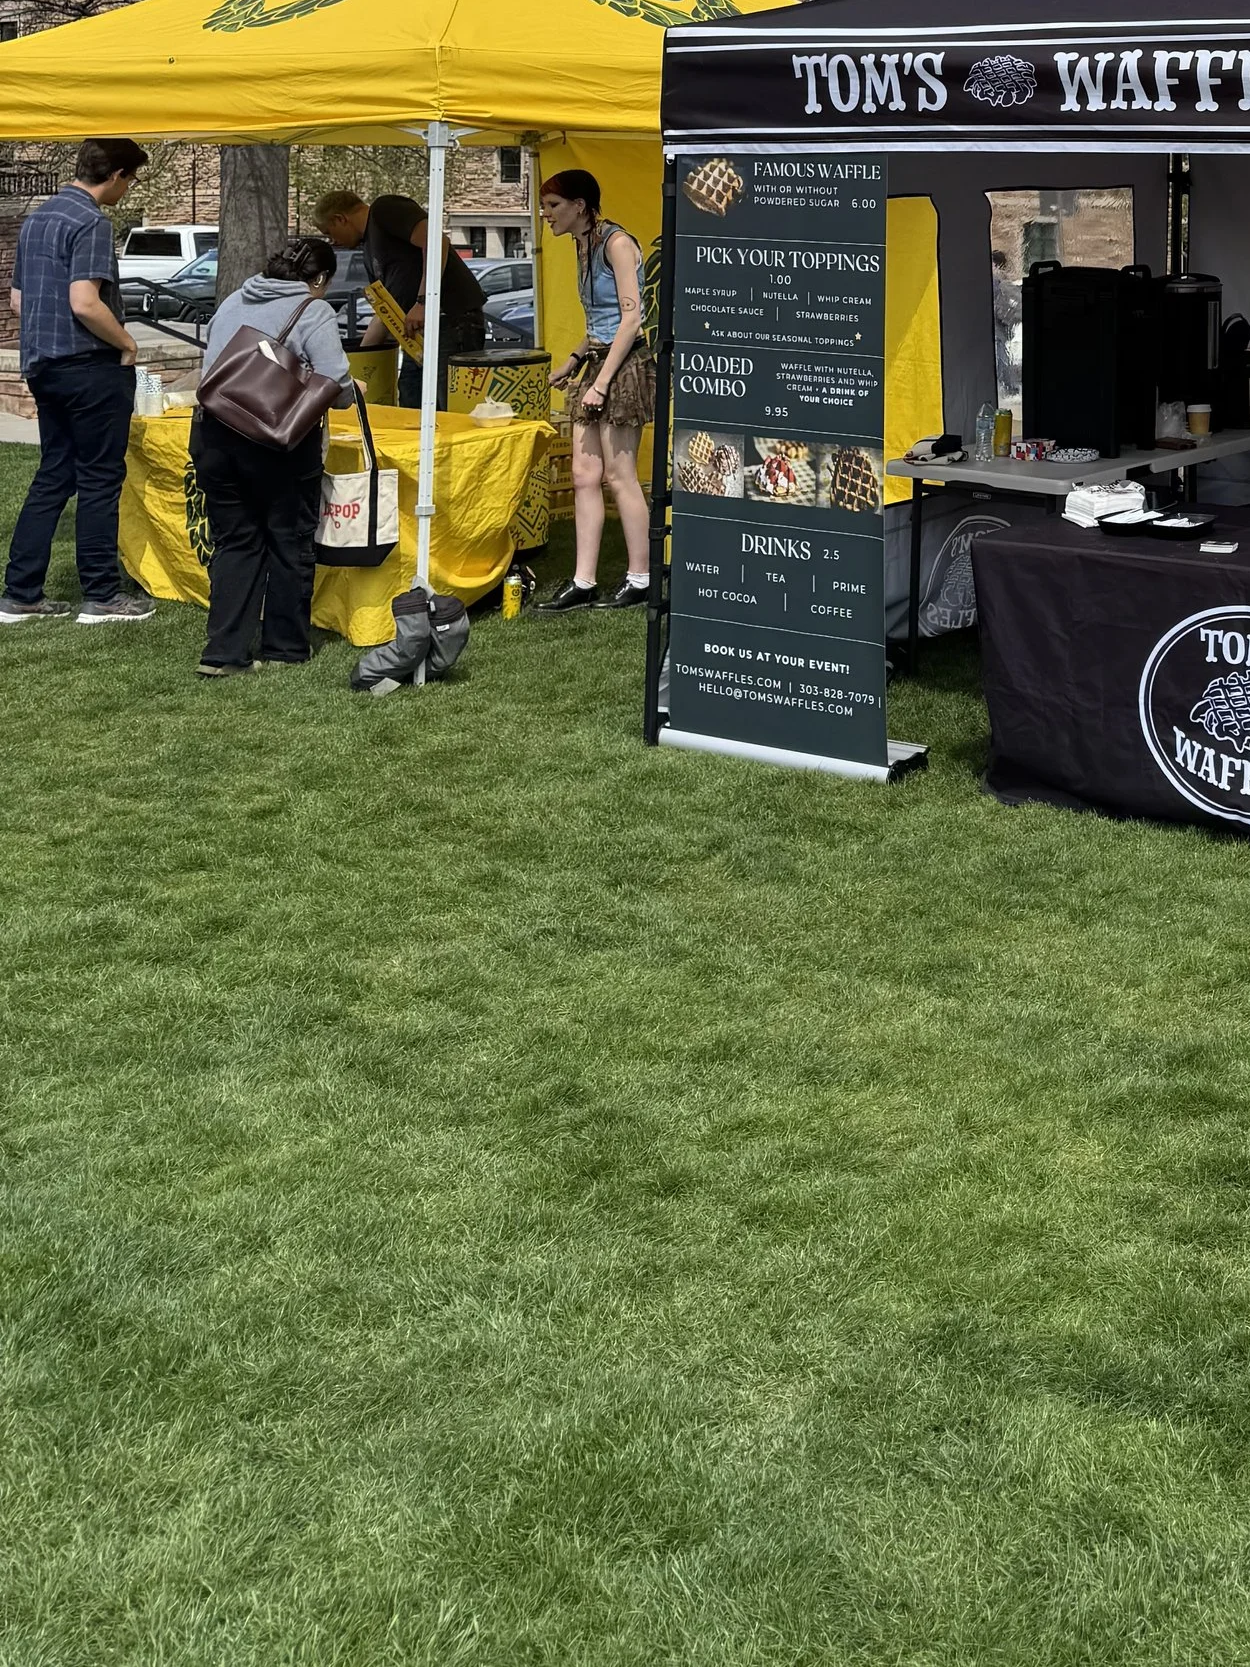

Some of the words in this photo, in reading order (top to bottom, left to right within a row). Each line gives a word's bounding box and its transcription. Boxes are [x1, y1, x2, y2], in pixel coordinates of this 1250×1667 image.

[791, 51, 948, 115] TOM'S
[754, 162, 815, 178] FAMOUS
[818, 164, 880, 180] WAFFLE
[754, 184, 777, 193] WITH
[779, 185, 792, 194] OR
[796, 186, 838, 195] WITHOUT
[754, 197, 806, 206] POWDERED
[809, 198, 840, 207] SUGAR
[851, 199, 876, 208] 6.00
[696, 246, 732, 264] PICK
[737, 248, 785, 268] YOUR
[789, 251, 880, 272] TOPPINGS
[769, 274, 792, 284] 1.00
[685, 287, 710, 296] MAPLE
[712, 289, 737, 297] SYRUP
[762, 292, 798, 301] NUTELLA
[817, 295, 840, 303] WHIP
[842, 296, 872, 305] CREAM
[690, 304, 736, 315] CHOCOLATE
[738, 306, 764, 316] SAUCE
[796, 311, 859, 322] STRAWBERRIES
[727, 331, 752, 339] ABOUT
[772, 334, 812, 344] SEASONAL
[815, 337, 854, 347] TOPPINGS
[680, 353, 754, 376] LOADED
[780, 362, 812, 372] WAFFLE
[814, 365, 834, 374] WITH
[837, 366, 874, 378] NUTELLA,
[680, 375, 746, 398] COMBO
[776, 373, 836, 384] STRAWBERRIES
[838, 377, 855, 386] AND
[858, 378, 878, 388] WHIP
[786, 384, 813, 393] CREAM
[830, 387, 856, 396] DRINK
[858, 389, 869, 397] OF
[799, 395, 820, 404] YOUR
[823, 397, 854, 406] CHOICE
[764, 406, 789, 417] 9.95
[741, 533, 811, 560] DRINKS
[823, 549, 840, 560] 2.5
[685, 561, 720, 575] WATER
[766, 572, 786, 583] TEA
[833, 581, 866, 595] PRIME
[698, 587, 719, 599] HOT
[722, 590, 758, 605] COCOA
[810, 605, 853, 619] COFFEE
[704, 644, 735, 657] BOOK
[738, 648, 752, 659] US
[756, 651, 772, 662] AT
[775, 654, 805, 668] YOUR
[809, 659, 850, 674] EVENT!
[675, 664, 782, 689] TOMSWAFFLES.COM
[799, 683, 875, 705] 303-828-7079
[699, 682, 854, 716] HELLO@TOMSWAFFLES.COM
